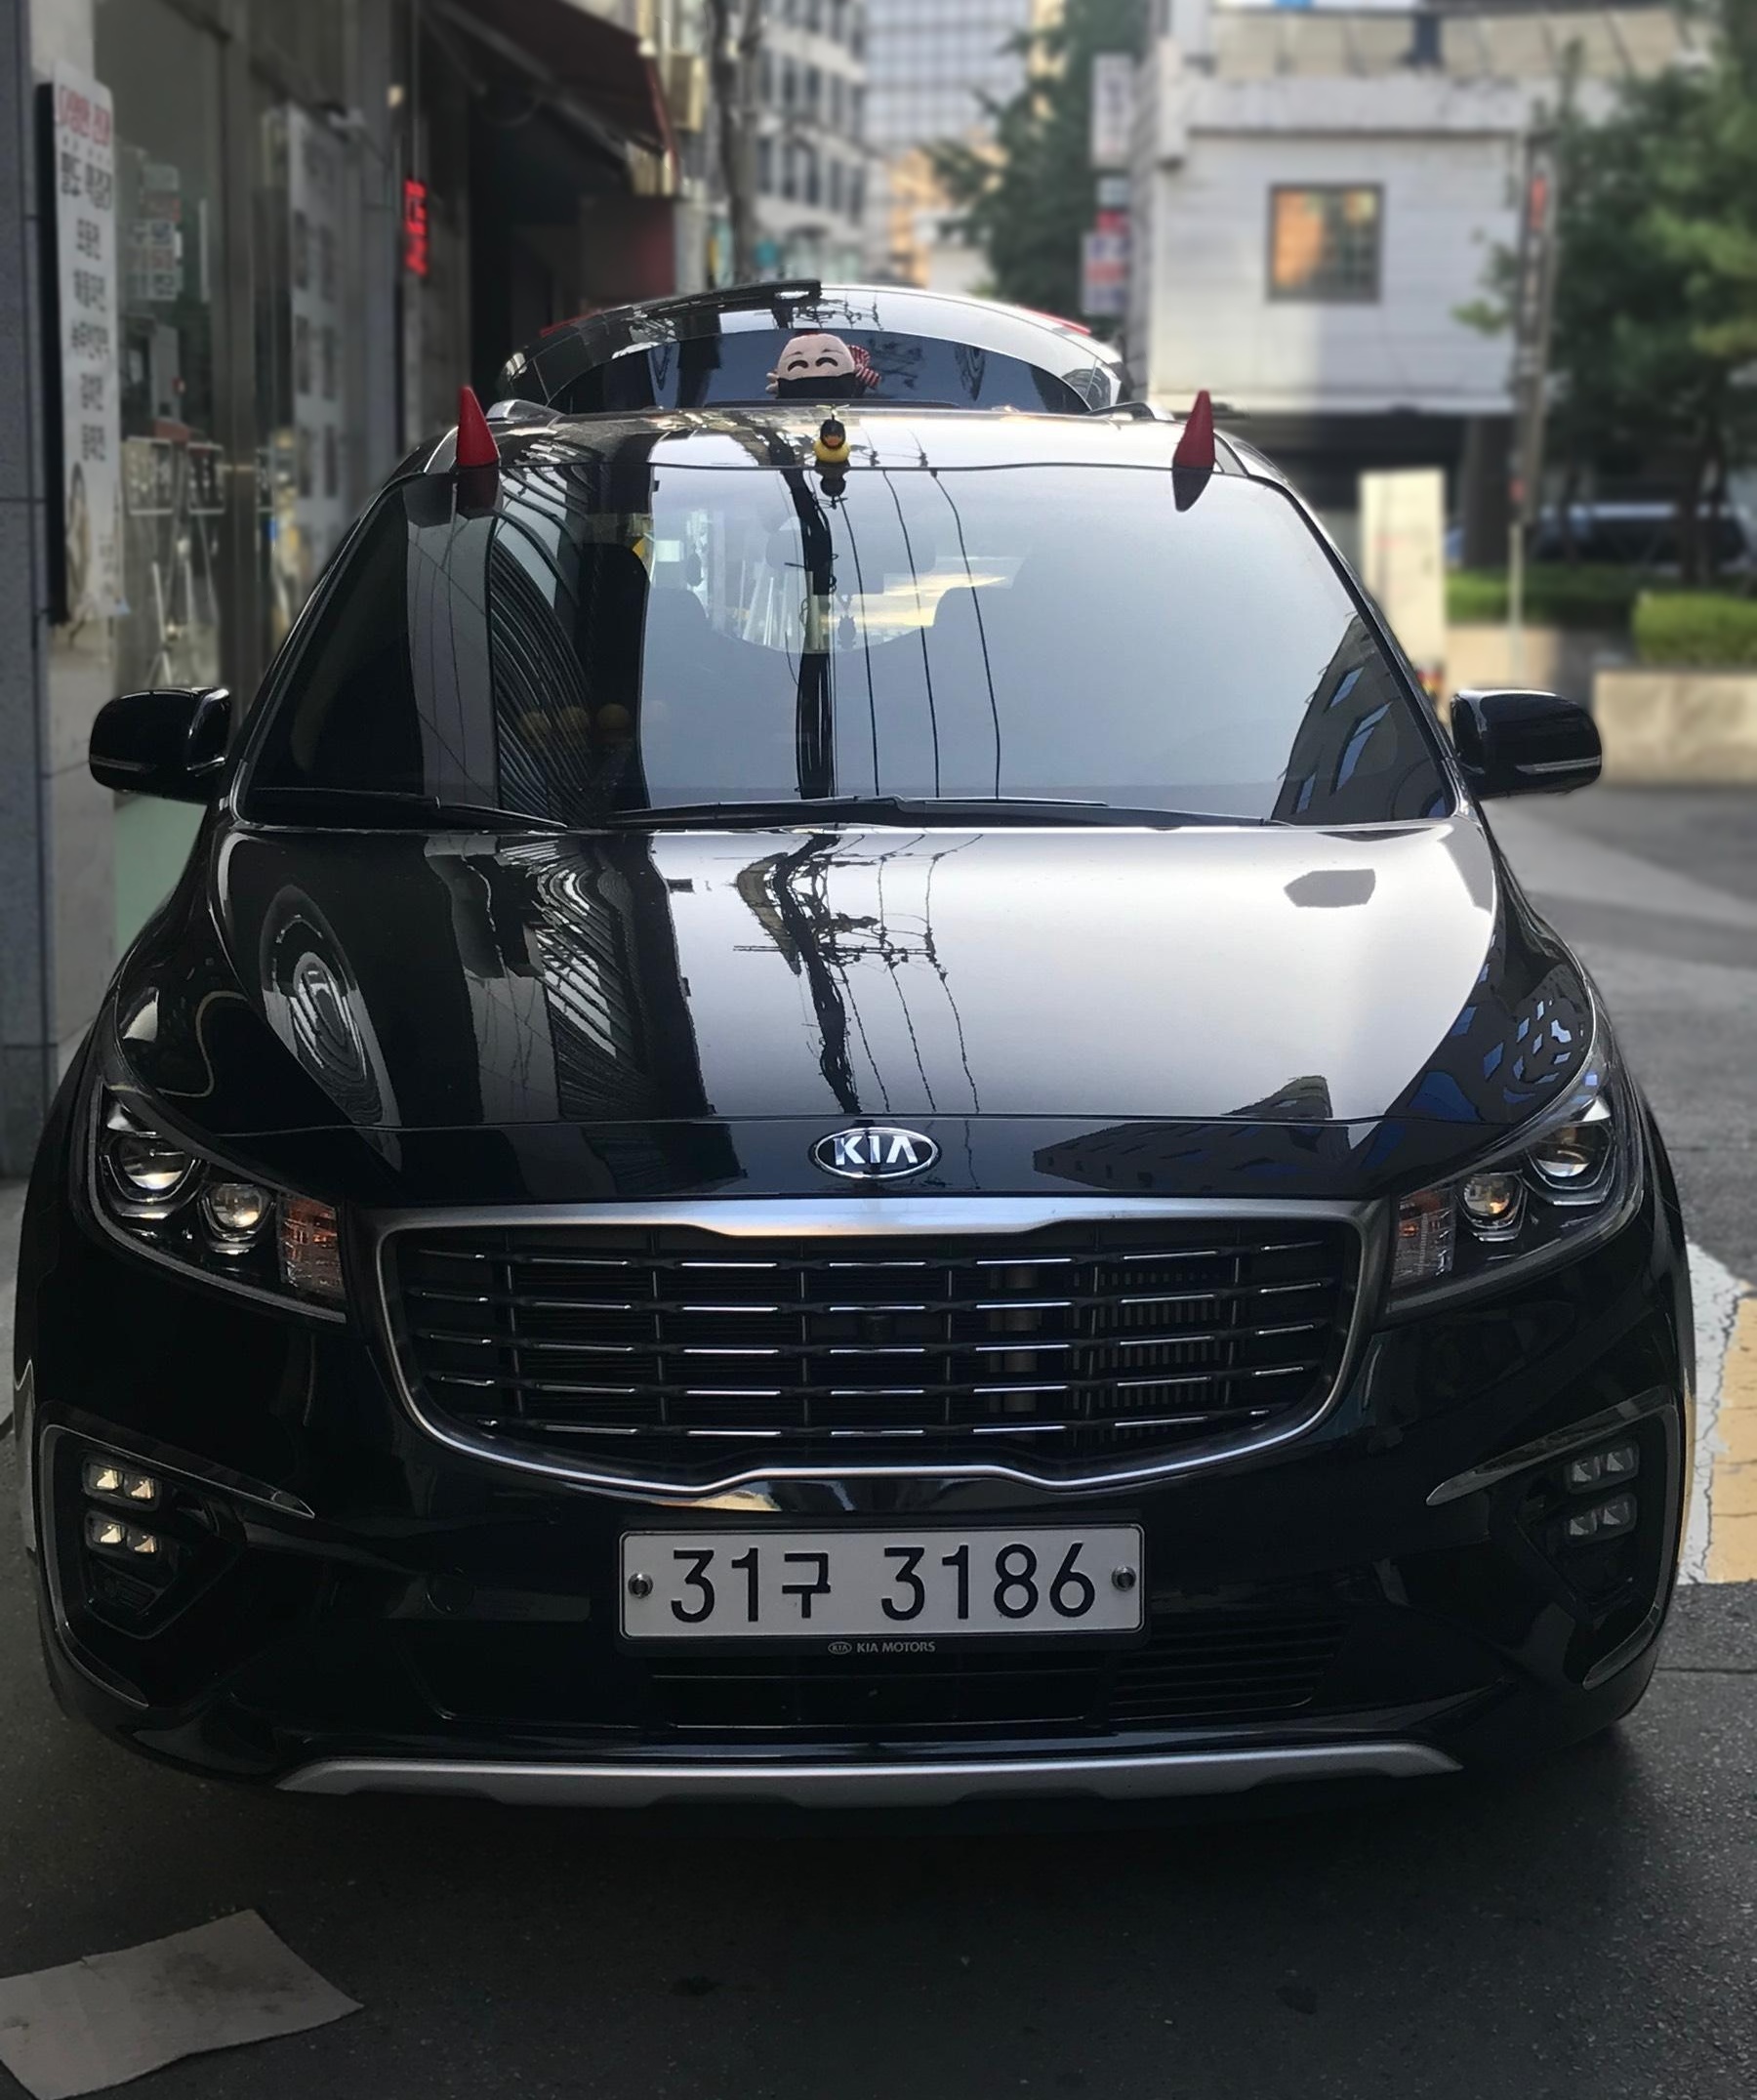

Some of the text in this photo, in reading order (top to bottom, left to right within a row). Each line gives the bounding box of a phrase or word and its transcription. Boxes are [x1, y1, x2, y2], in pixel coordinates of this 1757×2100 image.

[833, 1134, 919, 1166] KIA
[670, 1543, 1096, 1624] 31구 3186
[856, 1640, 936, 1653] KIA MOTORS
